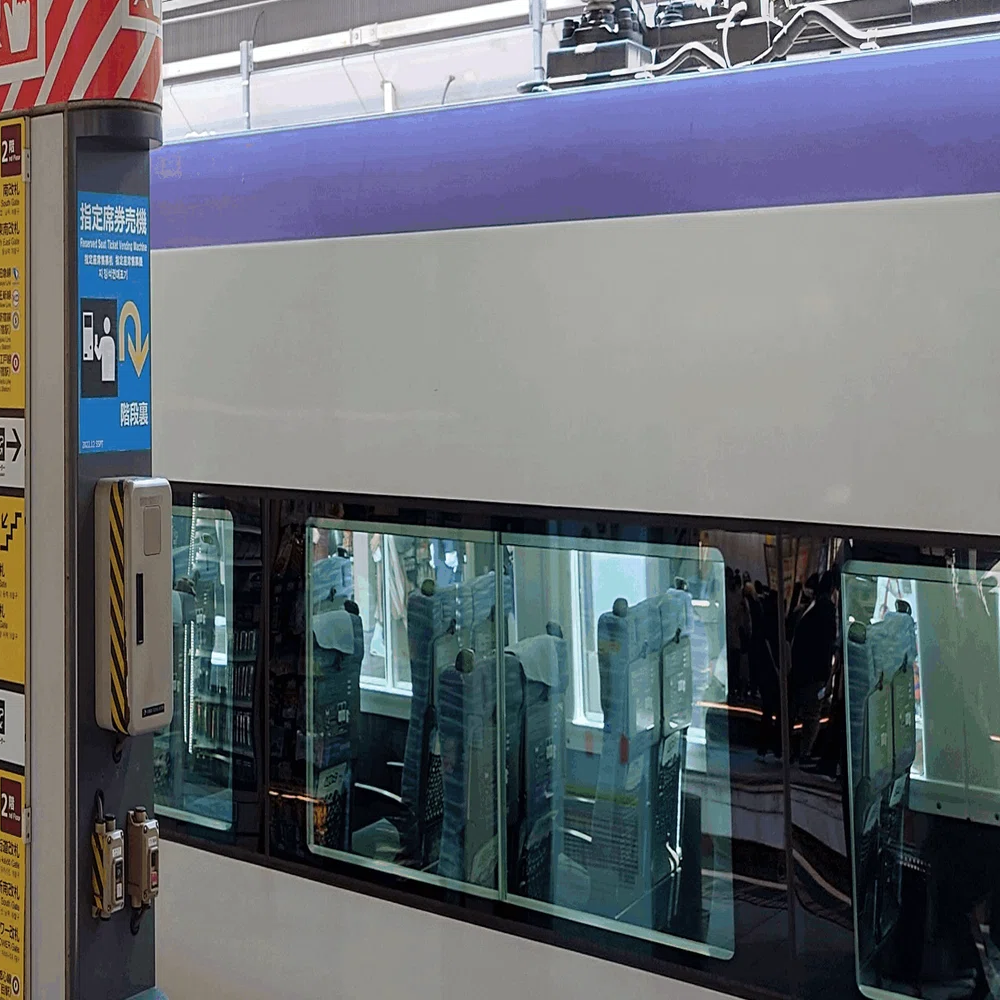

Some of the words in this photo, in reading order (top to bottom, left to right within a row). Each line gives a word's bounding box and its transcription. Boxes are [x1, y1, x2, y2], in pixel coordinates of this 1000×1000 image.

[2, 182, 20, 197] 南改札
[80, 202, 147, 236] 指定席券売機
[120, 402, 149, 427] 階段裏
